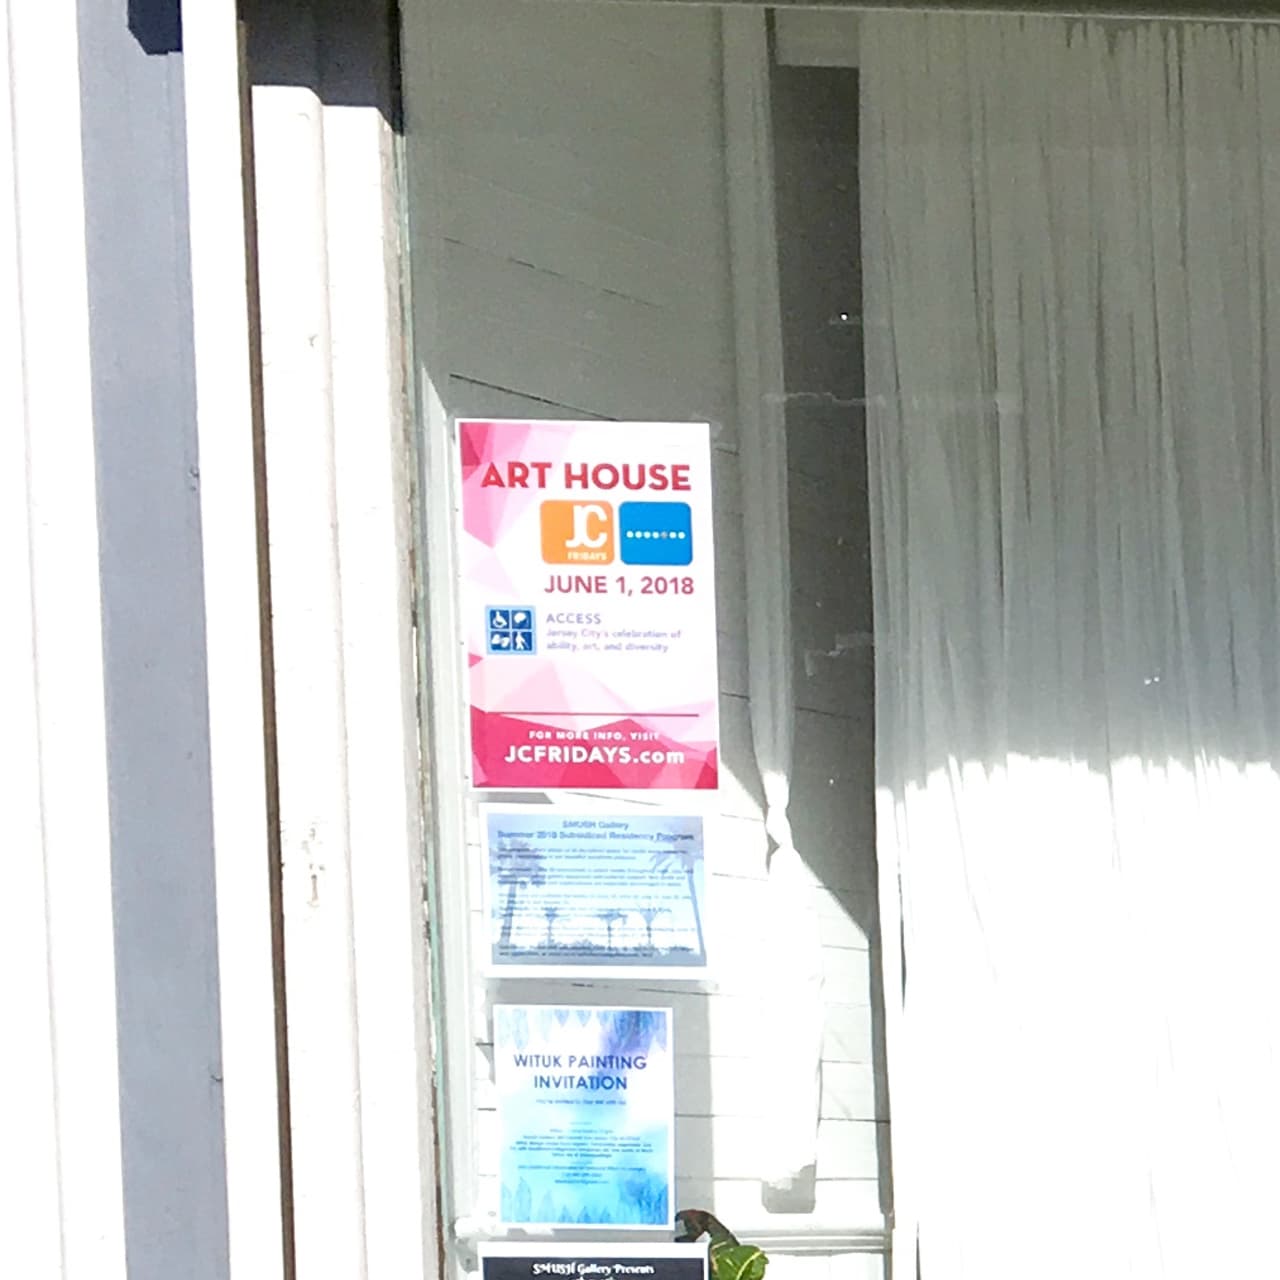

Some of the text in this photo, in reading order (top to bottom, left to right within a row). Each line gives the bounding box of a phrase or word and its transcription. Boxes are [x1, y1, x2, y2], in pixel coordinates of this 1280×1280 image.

[481, 461, 692, 491] ART HOUSE
[565, 504, 608, 548] JC
[544, 575, 694, 597] JUNE 1, 2018
[546, 613, 602, 625] ACCESS
[670, 629, 681, 638] of
[604, 642, 622, 651] and
[529, 730, 552, 739] FOR
[556, 731, 589, 740] MORE
[630, 732, 661, 741] VISIT
[505, 745, 685, 764] JCFRIDAYS.com
[514, 1054, 648, 1070] WITUK PAINTING
[534, 1075, 628, 1090] INVITATION
[577, 1263, 611, 1276] Gallery
[613, 1263, 655, 1274] Presents
